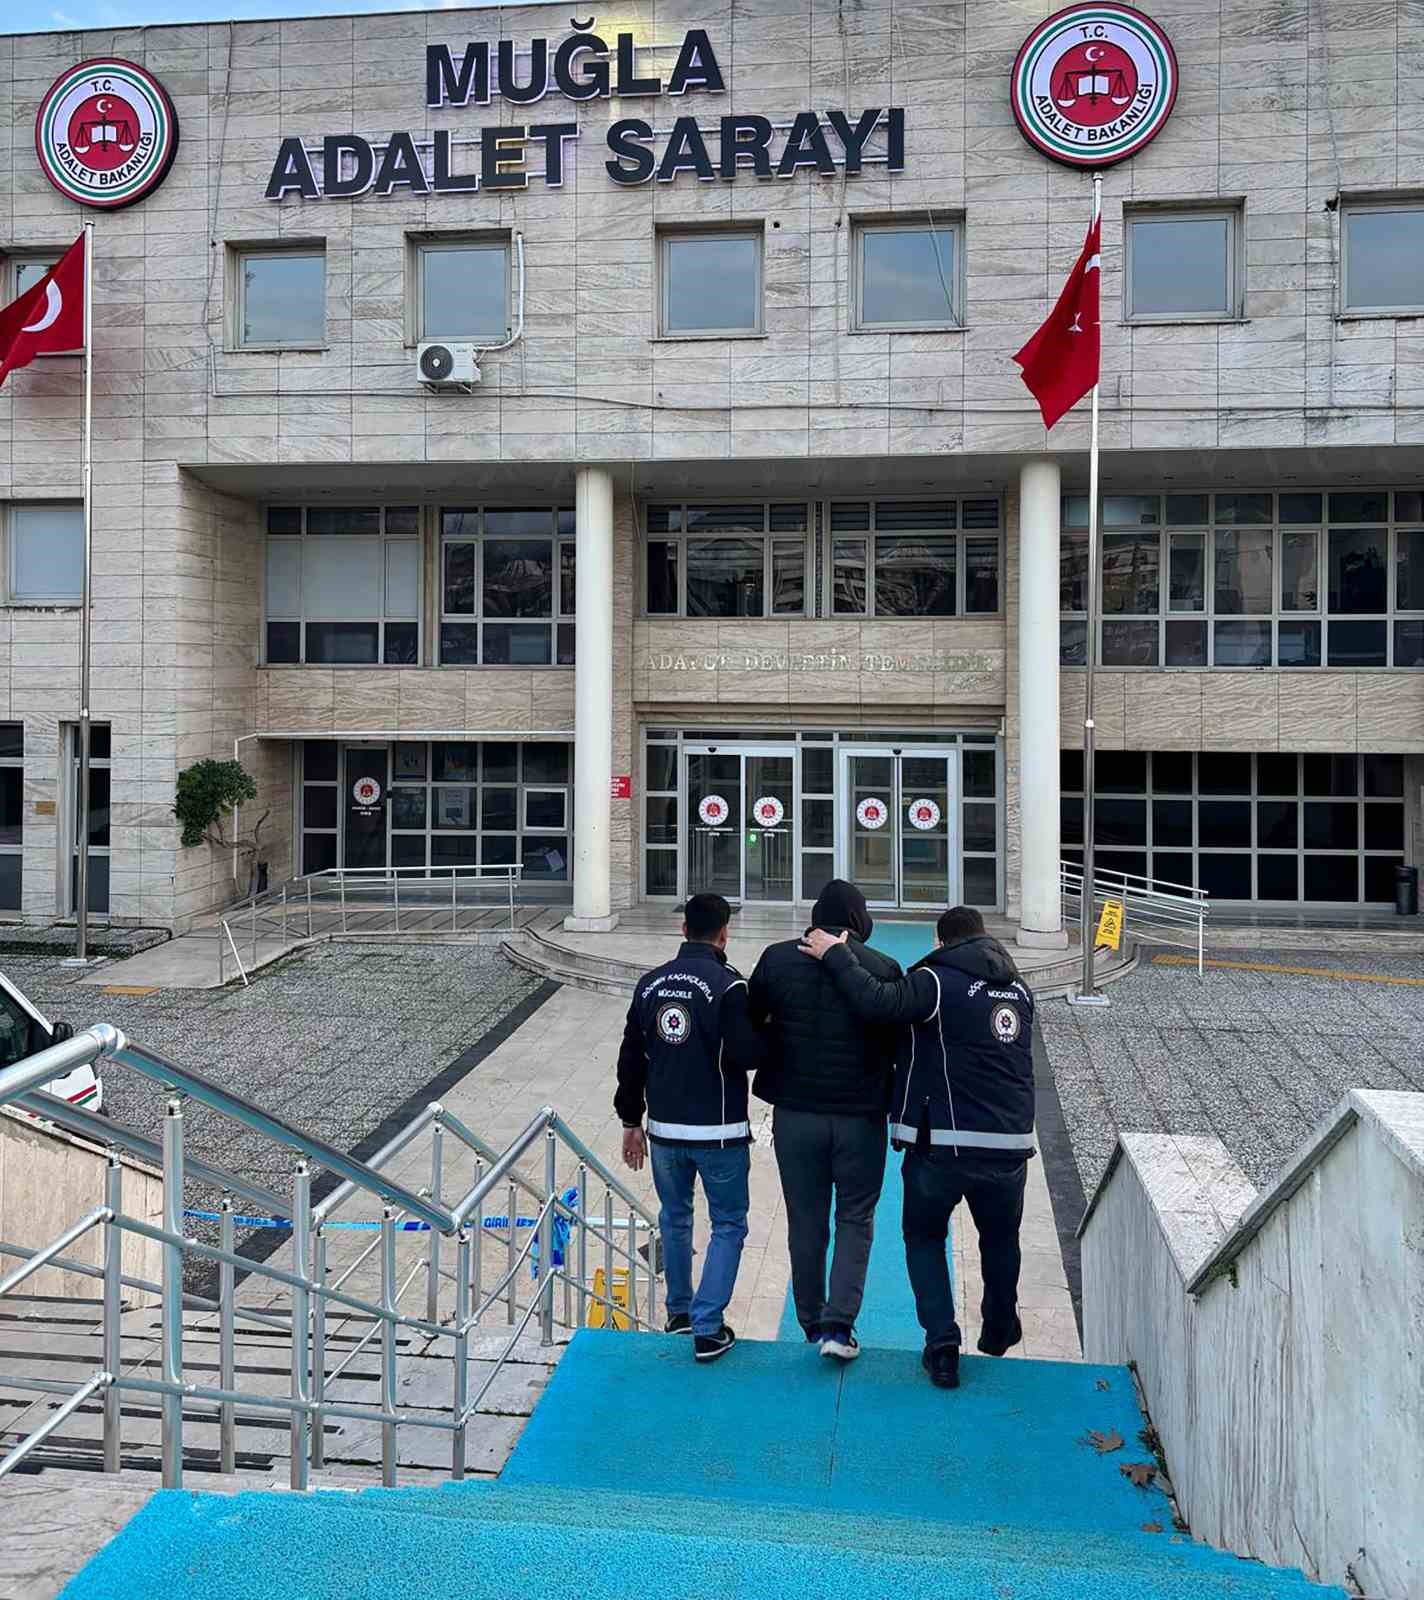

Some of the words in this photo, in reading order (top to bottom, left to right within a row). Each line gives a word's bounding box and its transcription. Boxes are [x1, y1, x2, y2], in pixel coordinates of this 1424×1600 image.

[1079, 25, 1109, 39] T.C.
[91, 79, 115, 92] T.C.
[425, 16, 726, 109] MUĞLA
[1035, 95, 1084, 140] ADALET
[1087, 83, 1154, 141] BAKANLIĞI
[56, 142, 97, 184] ADALET
[99, 131, 153, 185] BAKANLIĞI
[265, 121, 582, 200] ADALET
[604, 107, 905, 185] SARAYI
